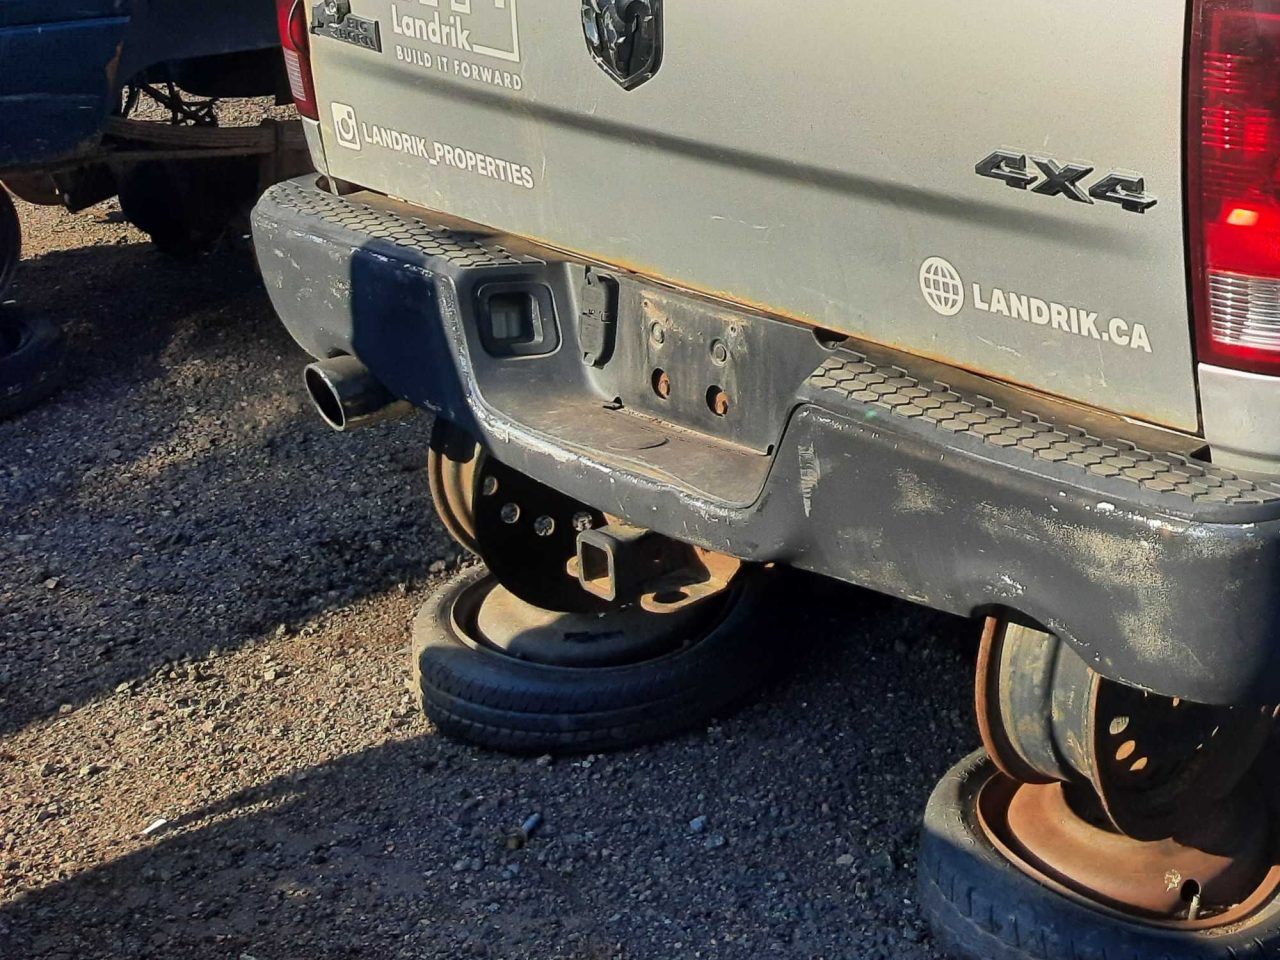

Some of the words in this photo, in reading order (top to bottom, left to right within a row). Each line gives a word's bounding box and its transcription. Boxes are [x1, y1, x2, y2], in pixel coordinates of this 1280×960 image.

[391, 4, 472, 52] Landrik
[395, 45, 432, 68] BUILD
[436, 56, 448, 72] IT
[453, 60, 522, 91] FORWARD
[361, 122, 535, 189] LANDRIK_PROPERTIES
[972, 282, 1153, 353] LANDRIK.CA
